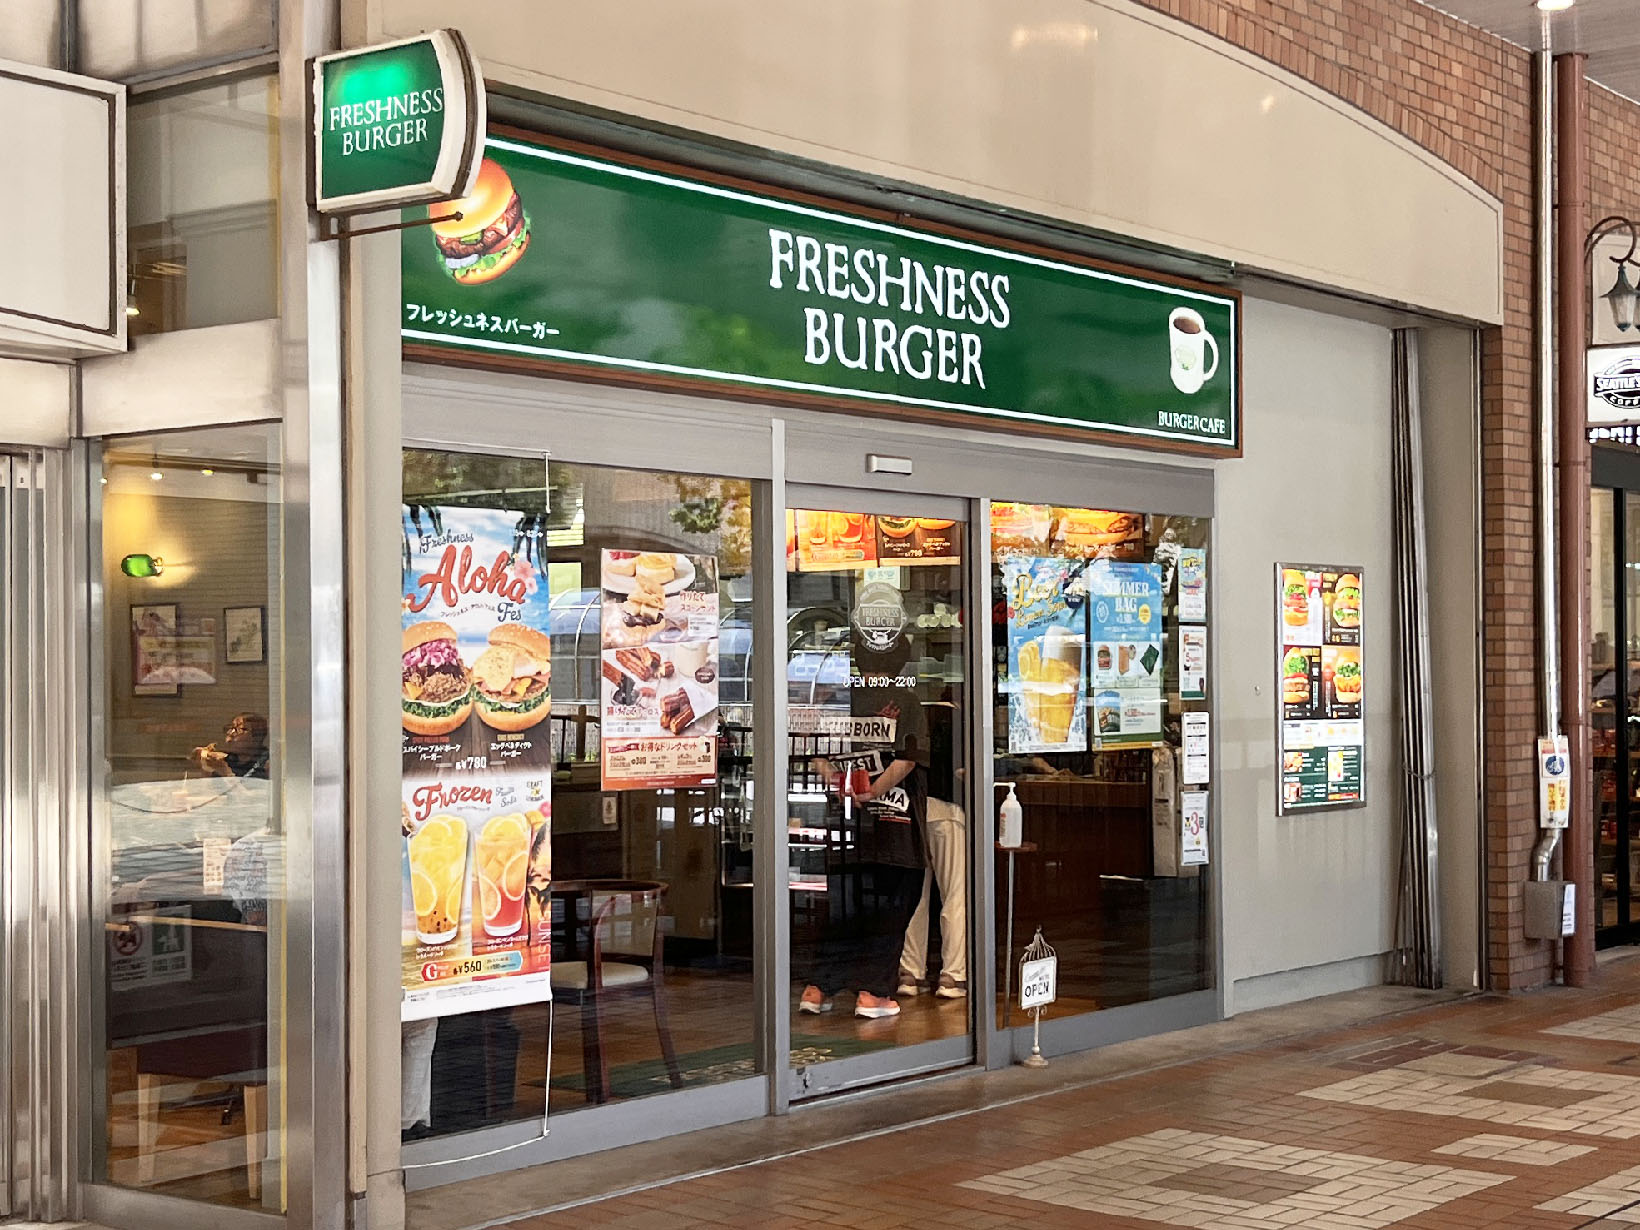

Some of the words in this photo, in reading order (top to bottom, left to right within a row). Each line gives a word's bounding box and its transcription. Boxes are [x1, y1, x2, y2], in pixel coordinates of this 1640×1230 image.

[329, 88, 444, 131] FRESHNESS
[342, 118, 428, 156] BURGER
[768, 228, 1010, 328] FRESHNESS
[406, 303, 560, 339] フレッシュネスバーガー
[803, 307, 986, 389] BURGER
[420, 528, 475, 554] Freshness
[406, 544, 527, 613] Aloha
[497, 602, 522, 622] Fes
[843, 676, 866, 688] OPEN
[412, 781, 494, 822] Frozen
[1024, 981, 1050, 998] OPEN
